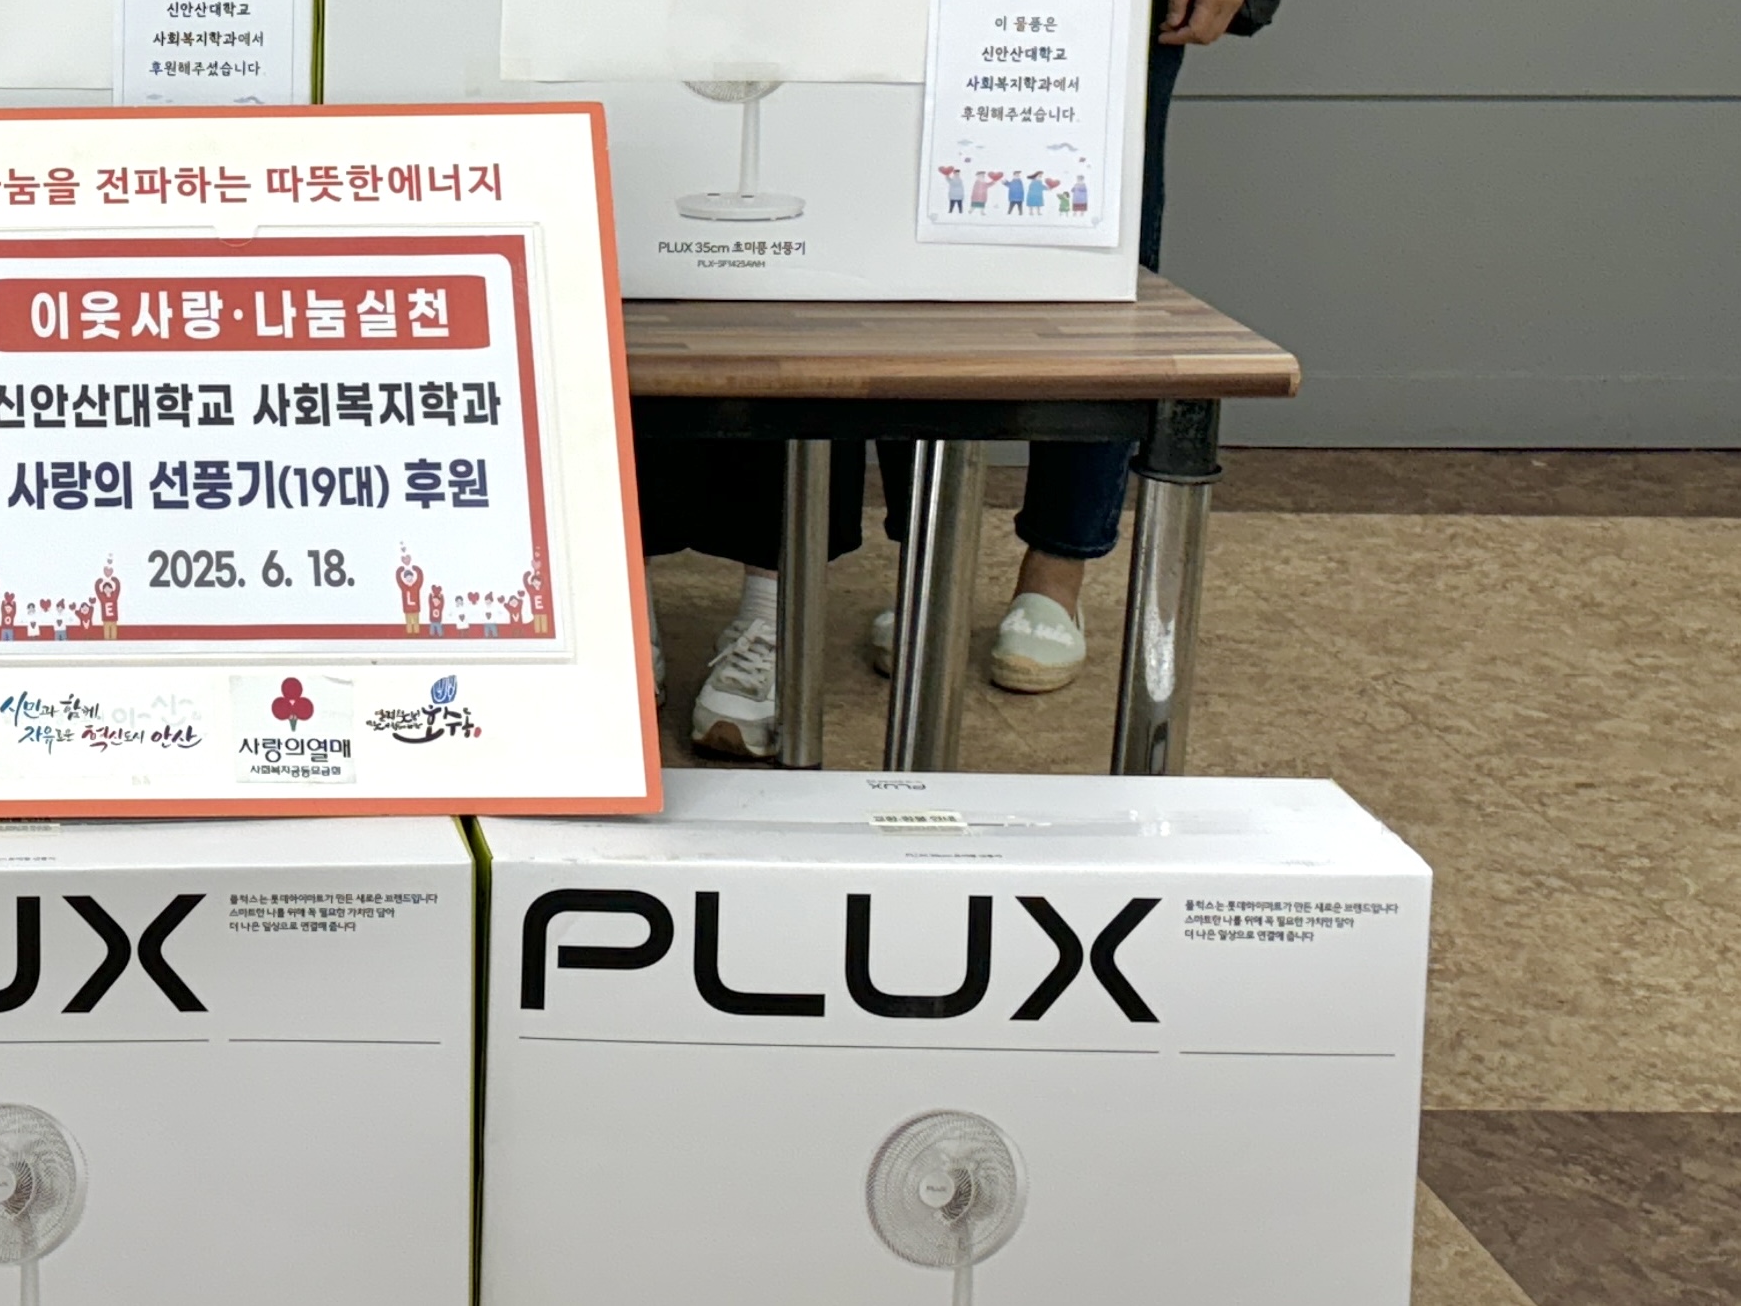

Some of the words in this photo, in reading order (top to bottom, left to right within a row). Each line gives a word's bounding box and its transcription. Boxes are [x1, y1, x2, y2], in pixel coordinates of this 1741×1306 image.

[167, 1, 251, 18] 신안산대학교
[995, 16, 1007, 31] 이
[1014, 16, 1058, 32] 물품은
[153, 31, 264, 46] 사회복지학과에서
[982, 46, 1067, 62] 신안산대학교
[966, 76, 1079, 92] 사회복지학과에서
[95, 165, 252, 205] 전파하는
[266, 162, 502, 204] 따뜻한에너지
[658, 242, 693, 253] PLUX
[695, 242, 729, 253] 35cm
[771, 241, 806, 255] 선풍기
[30, 288, 450, 340] 이웃사랑·나눔실천
[253, 380, 502, 428] 사회복지학과
[7, 460, 134, 511] 사랑의
[148, 459, 390, 511] 선풍기(19대)
[404, 457, 490, 510] 후원
[147, 549, 247, 589] 2025.
[261, 549, 293, 589] 6.
[306, 548, 356, 588] 18.
[0, 691, 58, 727] 시민과
[17, 724, 75, 755] 자유로운
[81, 725, 145, 752] 혁신도시
[150, 724, 203, 749] 안산
[238, 737, 352, 763] 사랑의열매
[520, 888, 1162, 1023] PLUX
